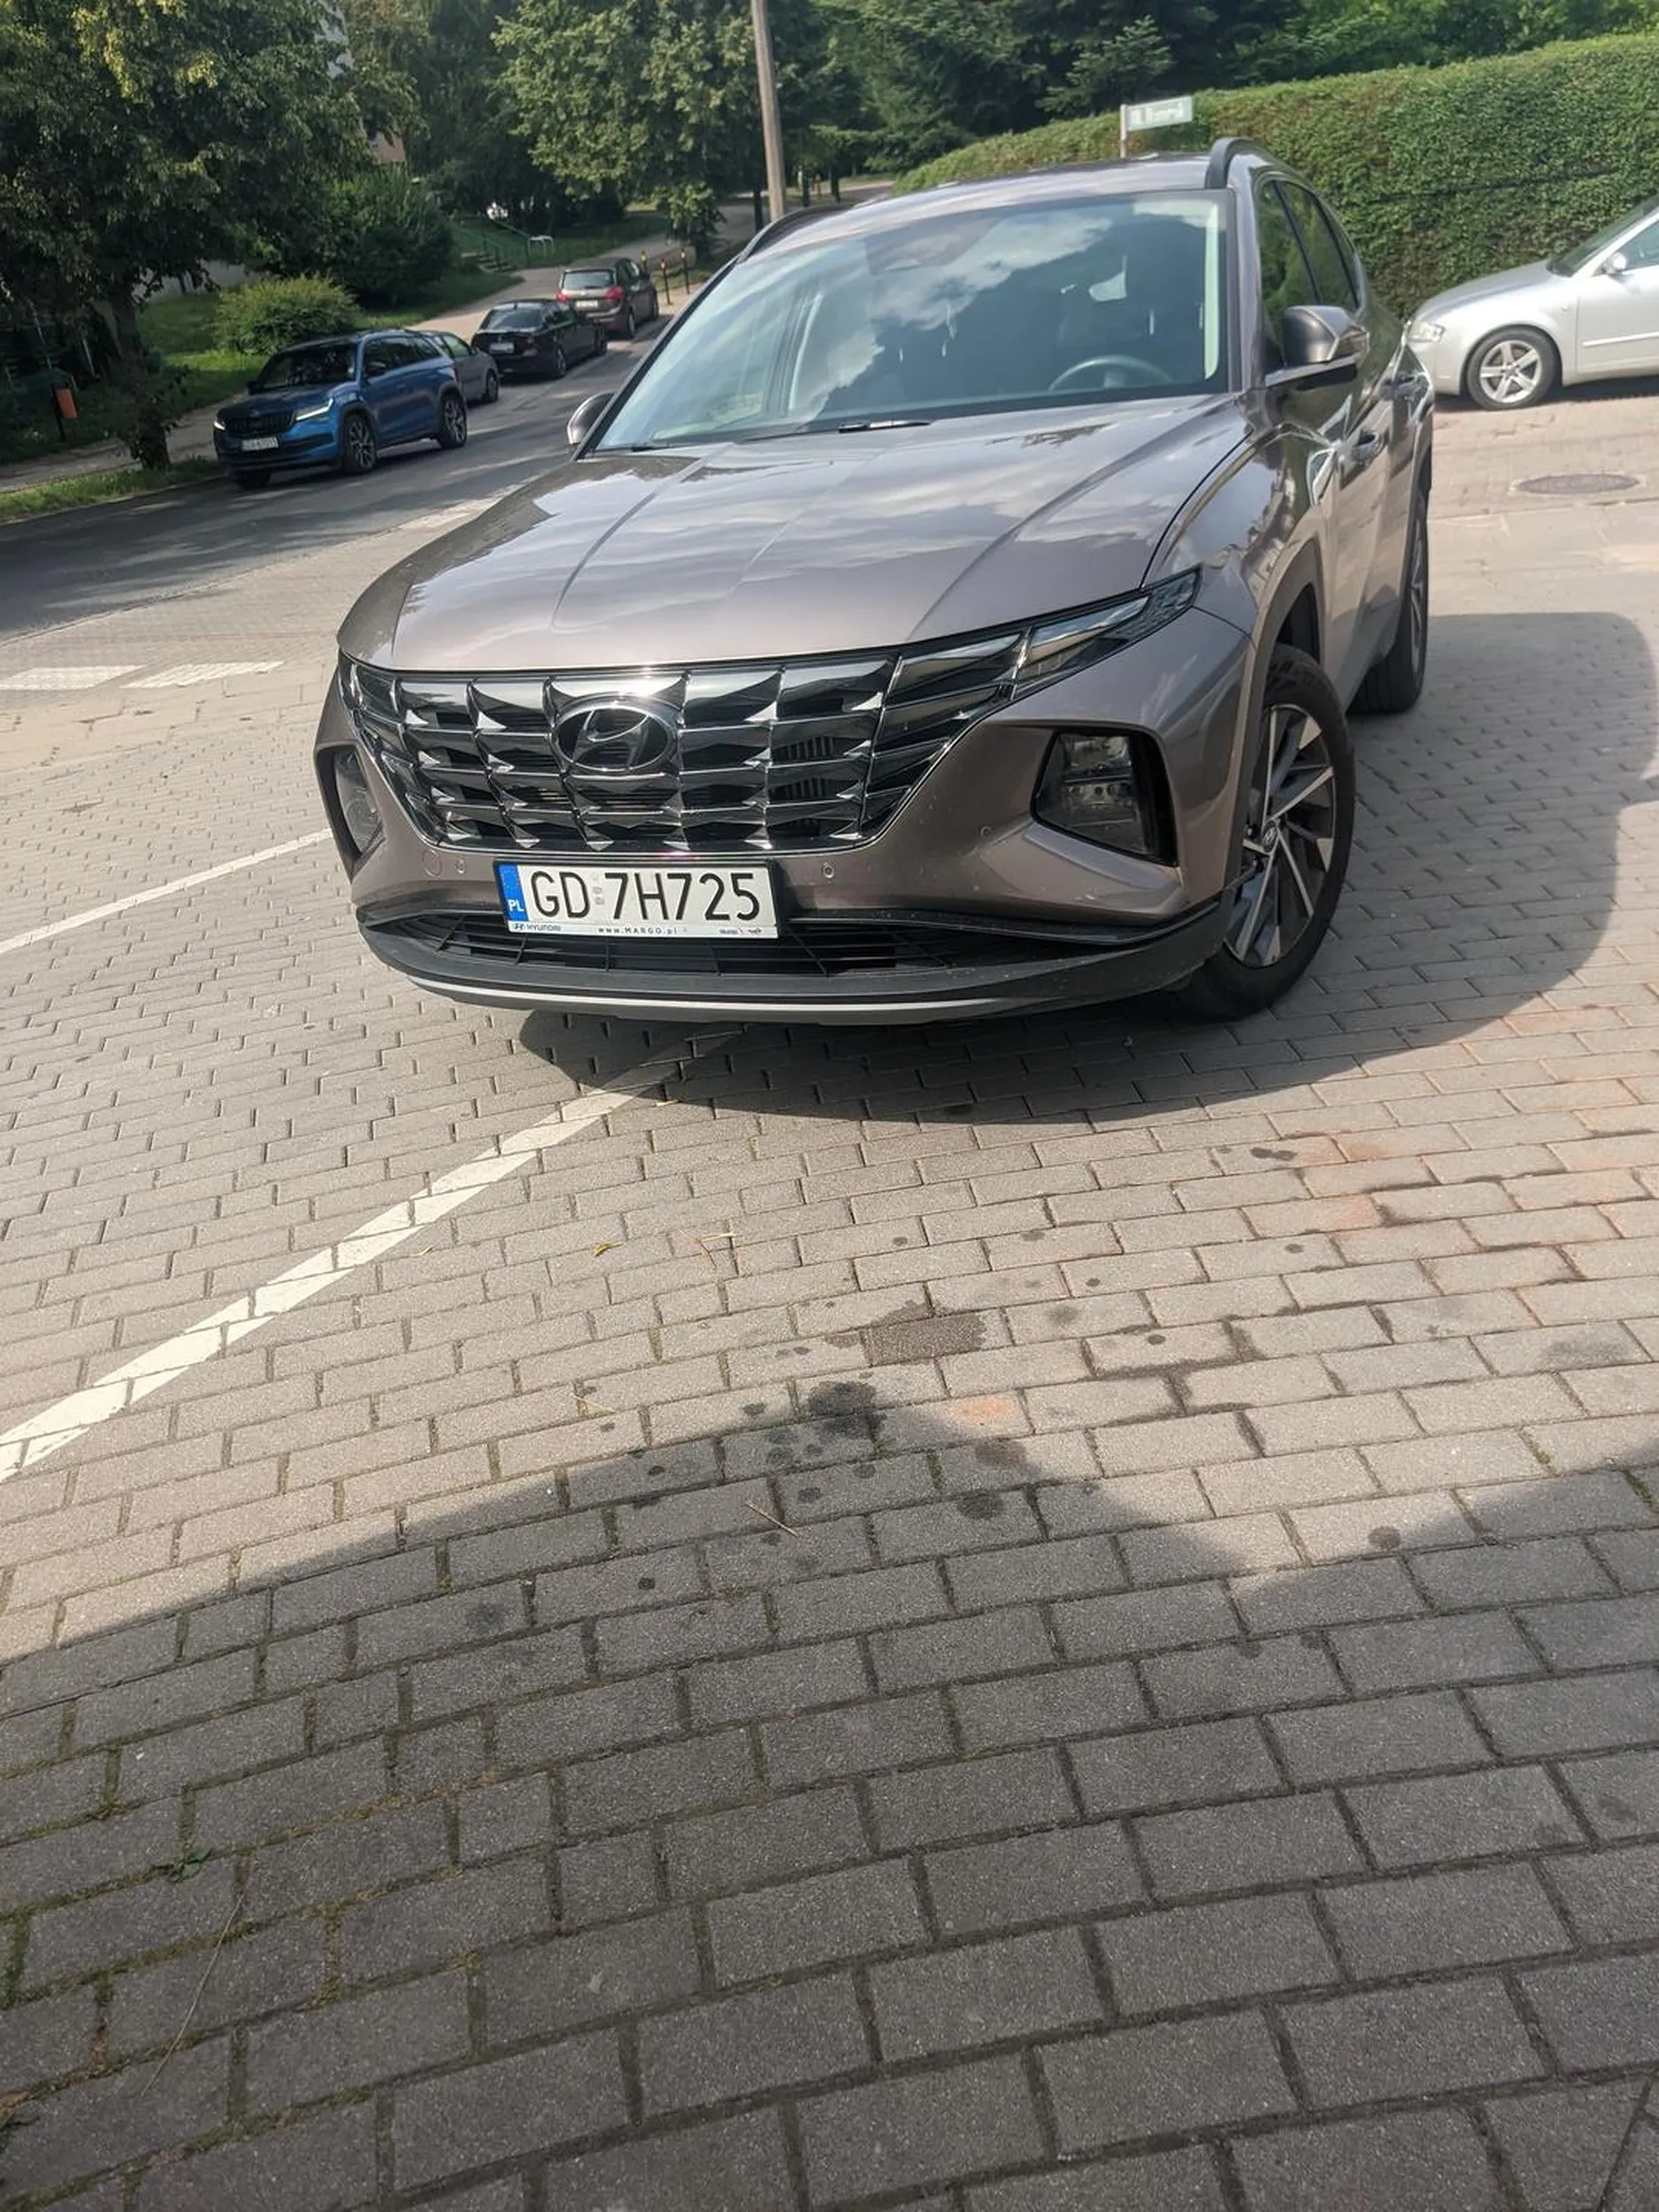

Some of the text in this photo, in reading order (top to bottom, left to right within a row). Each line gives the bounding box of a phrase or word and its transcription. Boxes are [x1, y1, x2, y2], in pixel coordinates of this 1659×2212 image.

[507, 899, 524, 912] PL
[530, 871, 760, 921] GD 7H725
